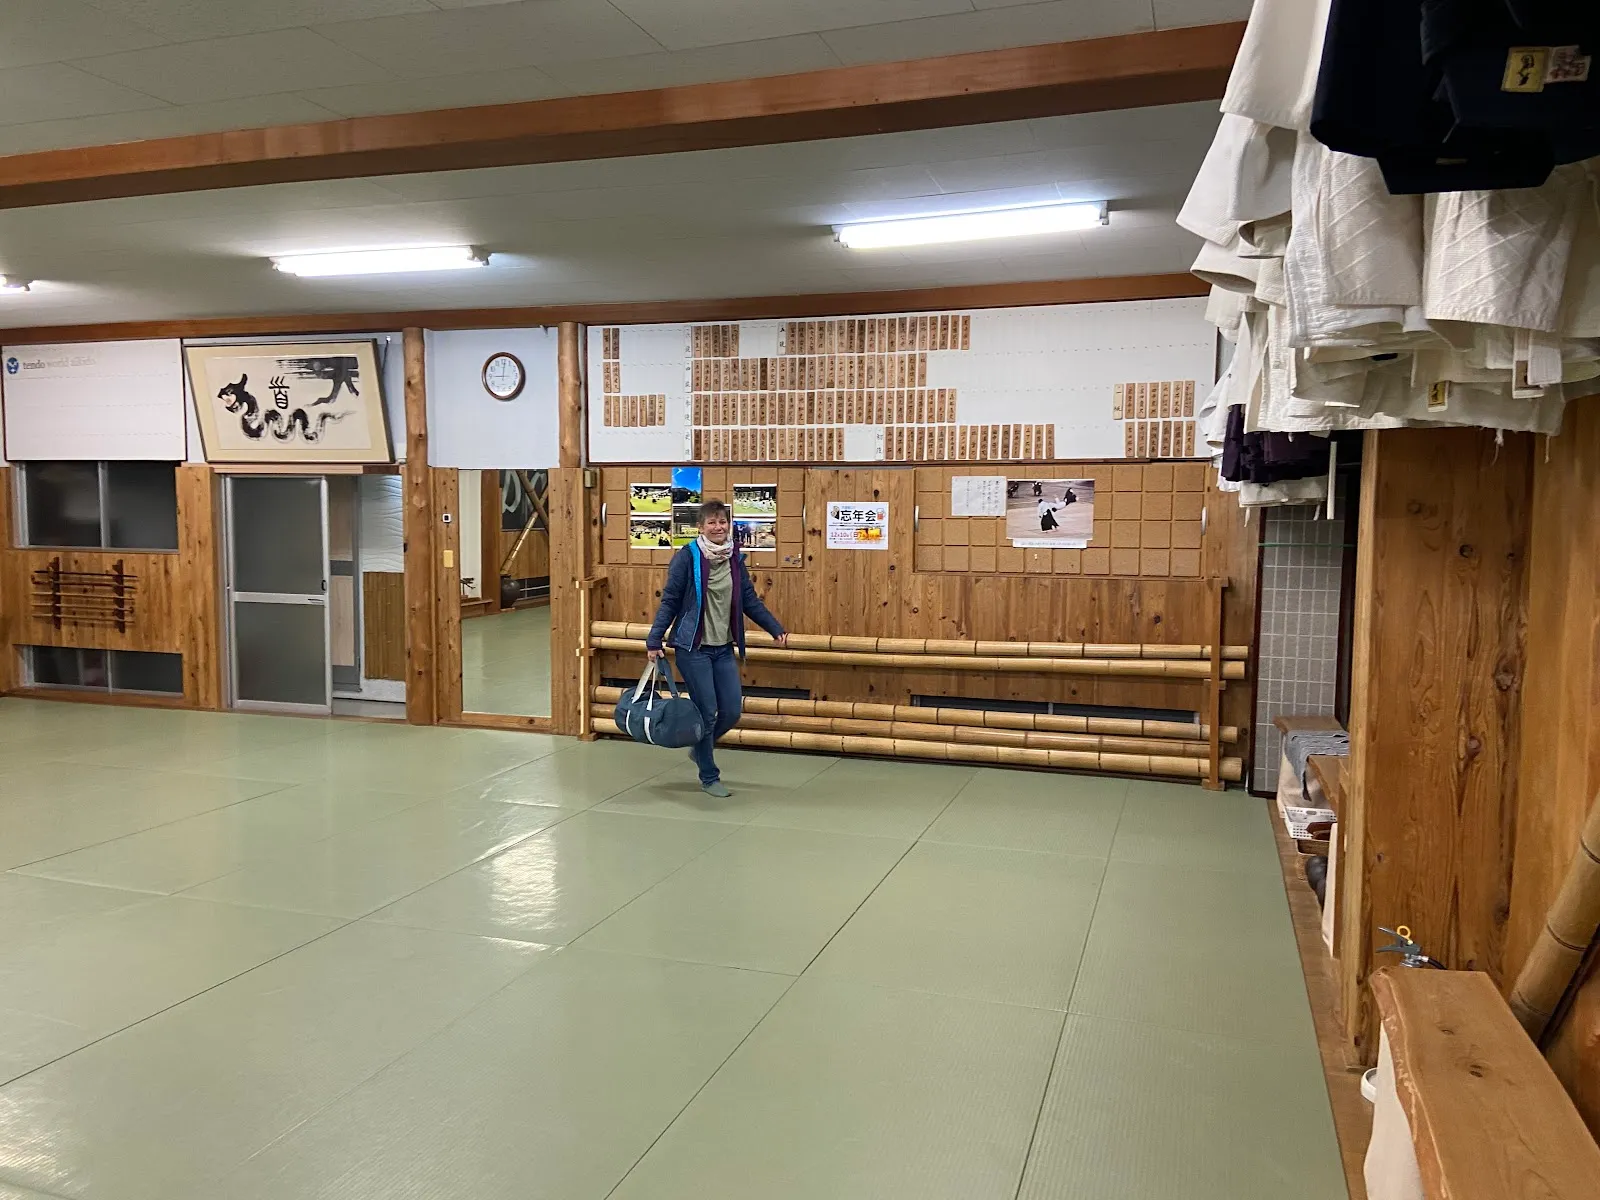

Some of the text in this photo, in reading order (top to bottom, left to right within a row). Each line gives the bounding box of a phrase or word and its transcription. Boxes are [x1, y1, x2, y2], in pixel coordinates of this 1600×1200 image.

[22, 360, 45, 370] tendo
[840, 510, 877, 522] 忘年会
